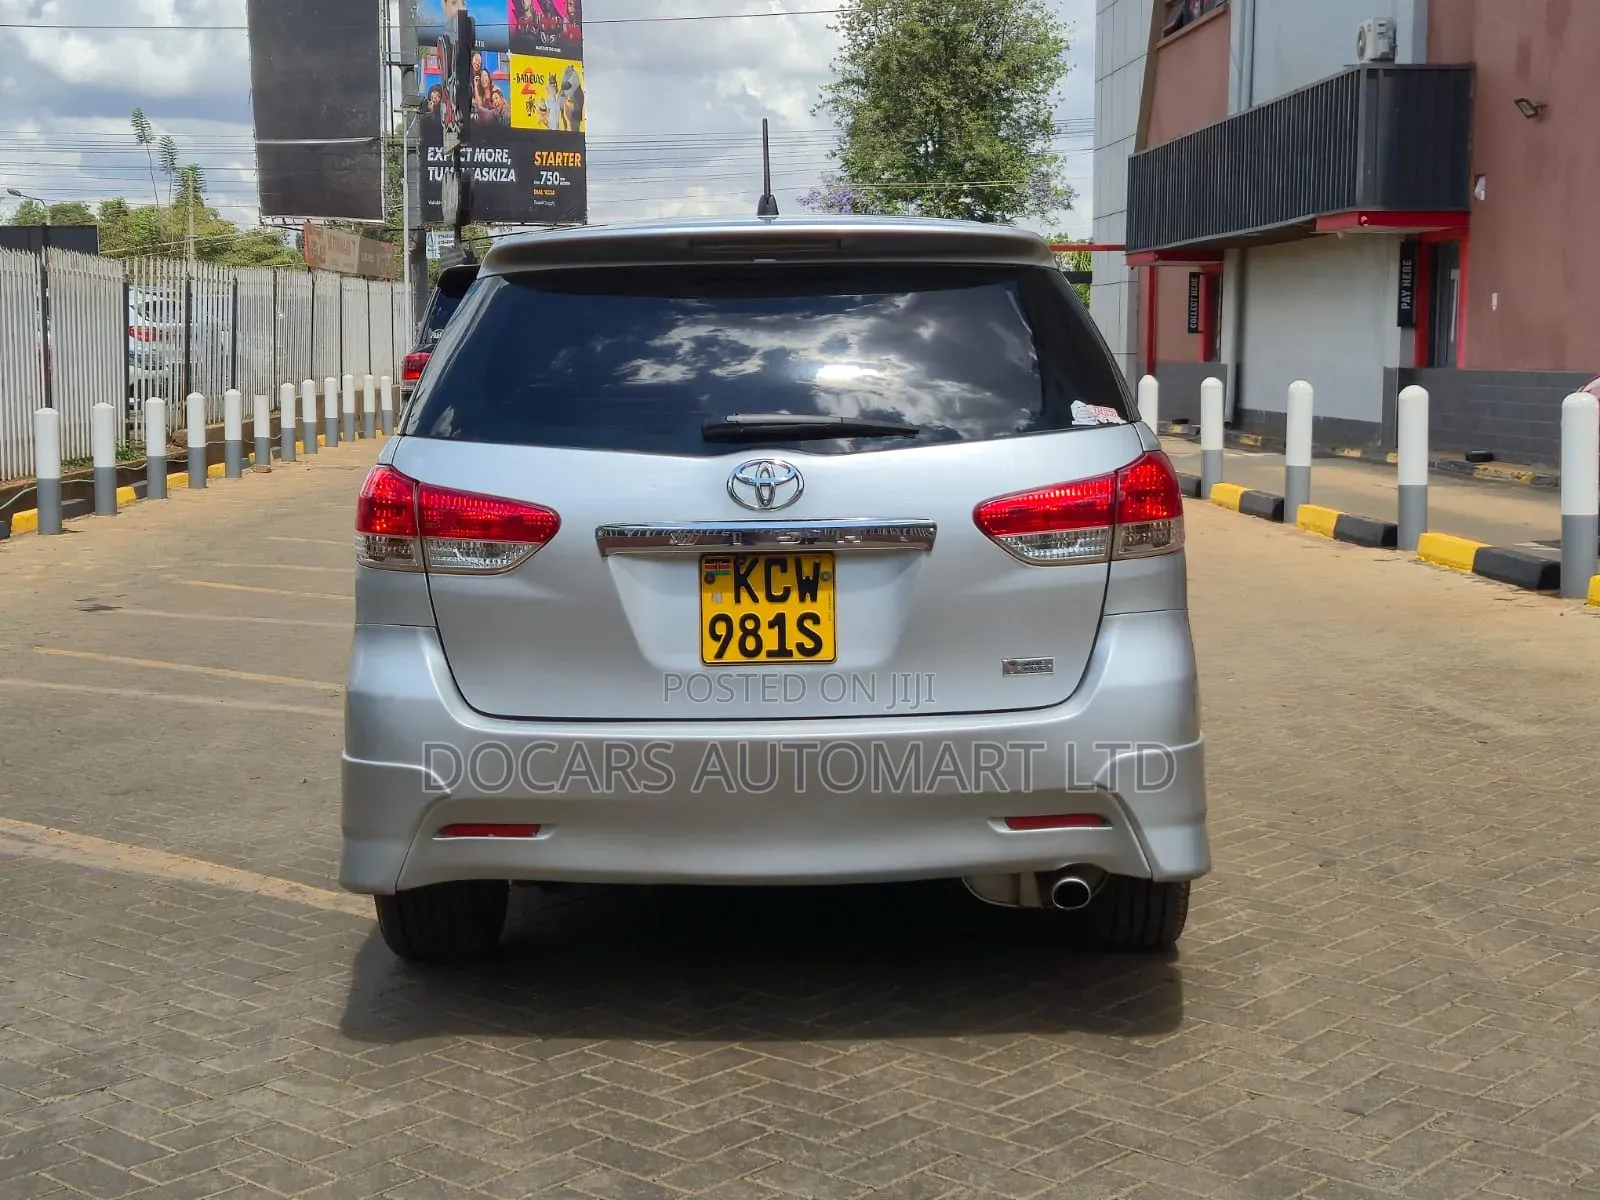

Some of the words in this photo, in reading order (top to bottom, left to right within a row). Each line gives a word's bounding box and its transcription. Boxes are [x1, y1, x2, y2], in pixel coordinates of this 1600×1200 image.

[427, 146, 473, 162] EXCT
[473, 148, 512, 165] MORE,
[534, 151, 582, 167] STARTER
[427, 166, 516, 182] TUASKIZA
[540, 171, 560, 186] 750
[1402, 259, 1412, 287] HERE
[1400, 290, 1411, 310] PAY
[733, 556, 821, 604] KCW
[708, 611, 823, 659] 981S
